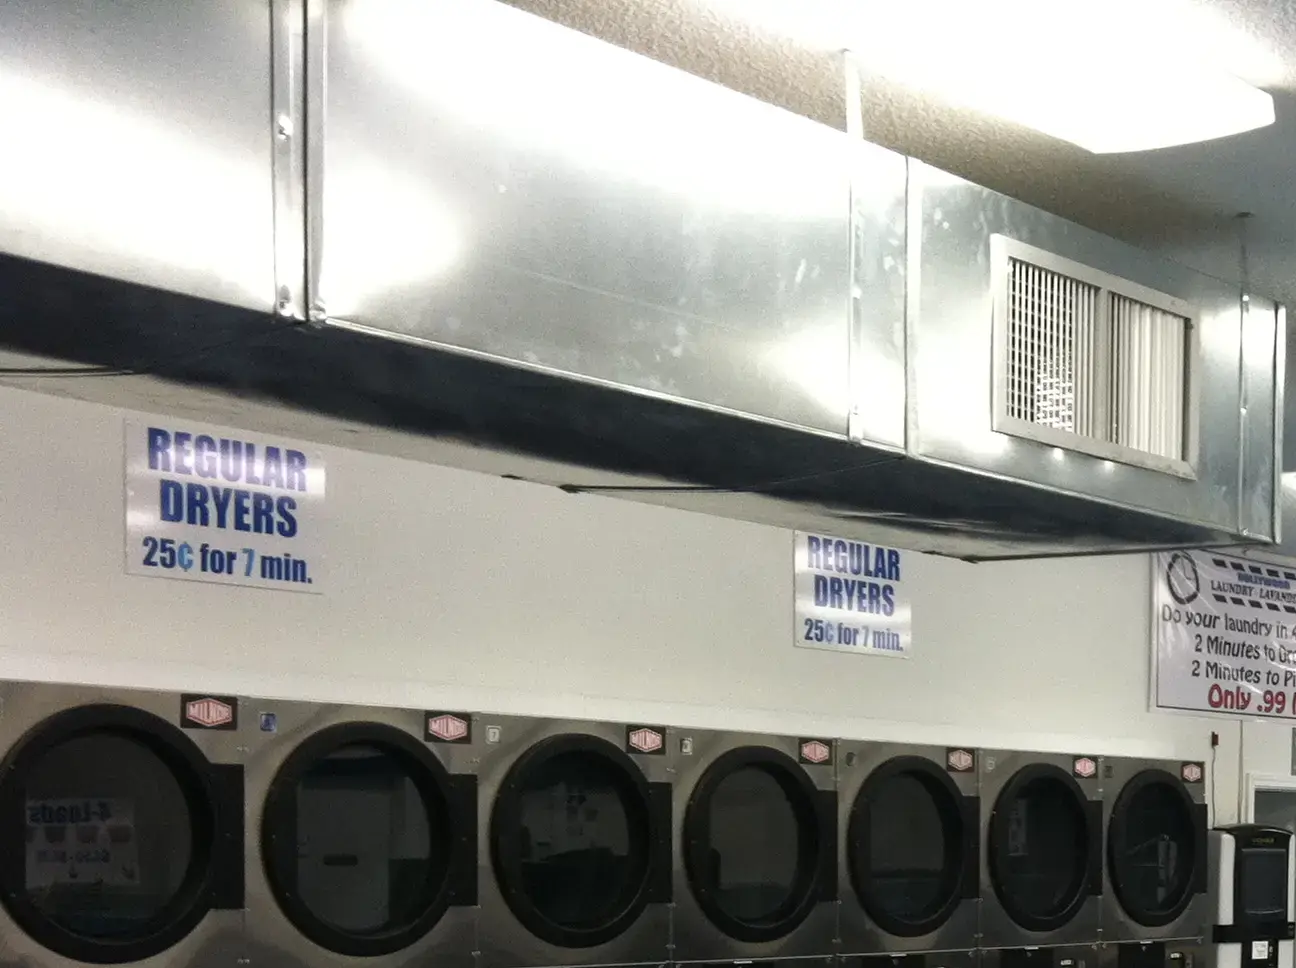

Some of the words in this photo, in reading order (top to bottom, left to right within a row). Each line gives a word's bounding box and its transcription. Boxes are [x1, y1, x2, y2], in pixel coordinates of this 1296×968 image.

[147, 427, 307, 492] REGULAR
[160, 479, 298, 538] DRYERS
[142, 536, 194, 572] 25¢
[200, 543, 237, 575] for
[242, 548, 255, 577] 7
[260, 553, 313, 584] min.
[807, 535, 901, 582] REGULAR
[814, 574, 895, 617] DRYERS
[1210, 580, 1255, 597] LAUNDRY
[804, 617, 834, 643] 25¢
[838, 622, 859, 646] for
[861, 625, 870, 647] 7
[873, 628, 904, 652] min.
[1162, 604, 1182, 624] Do
[1185, 609, 1221, 629] your
[1225, 613, 1272, 639] laundry
[1276, 621, 1288, 639] in
[1194, 633, 1203, 653] 2
[1206, 635, 1261, 660] Minutes
[1264, 644, 1275, 662] to
[1191, 659, 1200, 677] 2
[1206, 661, 1261, 684] Minutes
[1266, 671, 1280, 686] to
[1208, 683, 1251, 711] Only
[1257, 689, 1286, 714] .99
